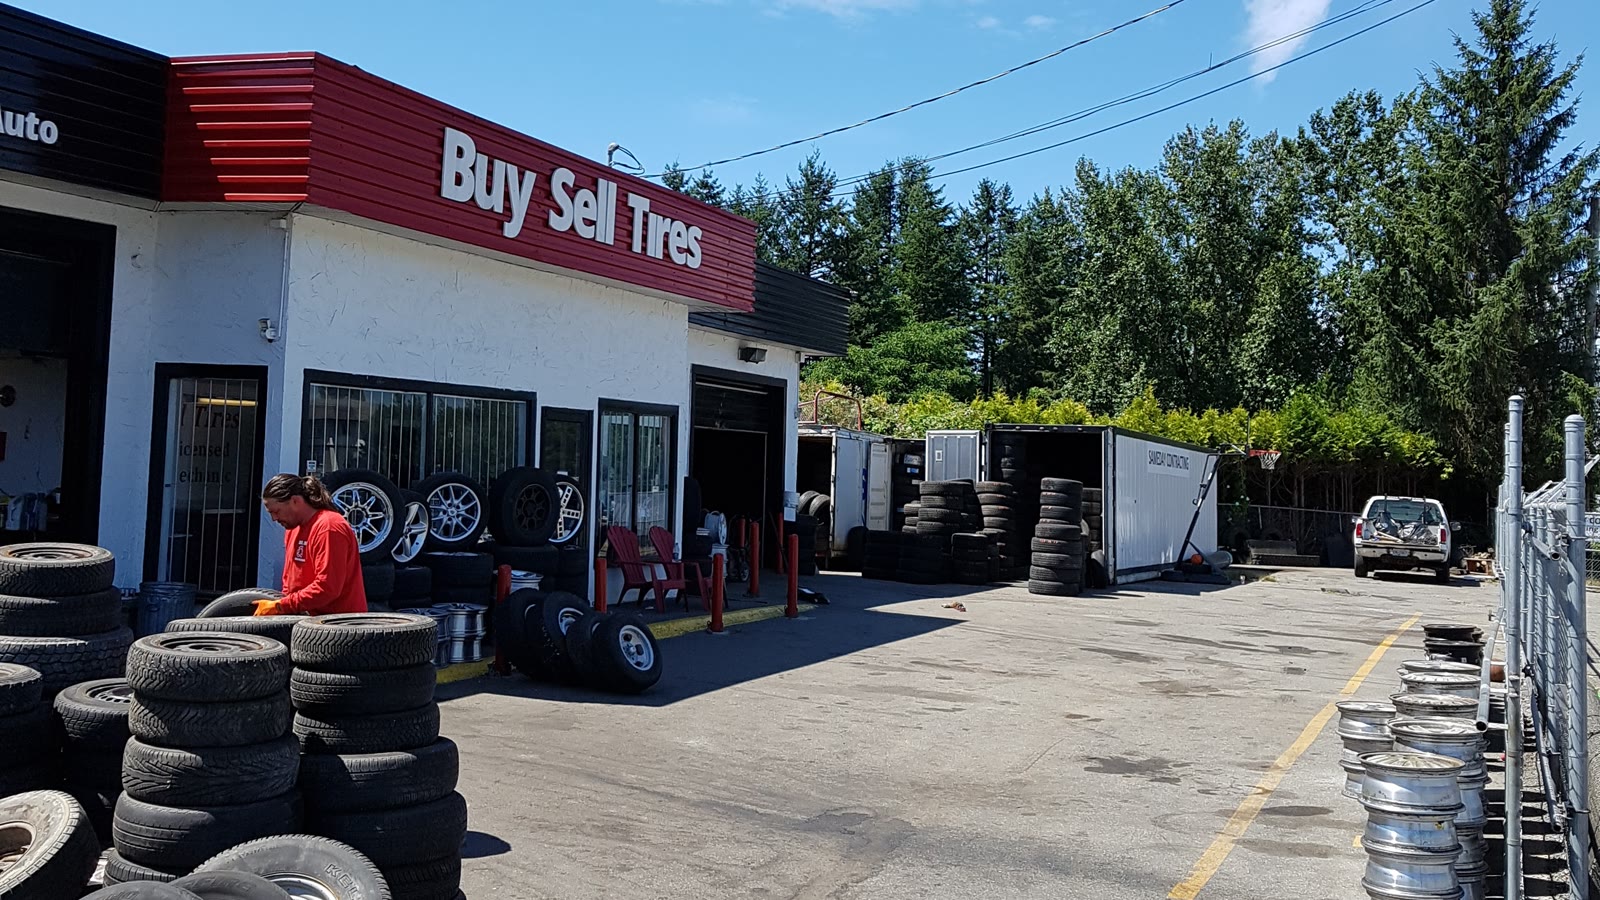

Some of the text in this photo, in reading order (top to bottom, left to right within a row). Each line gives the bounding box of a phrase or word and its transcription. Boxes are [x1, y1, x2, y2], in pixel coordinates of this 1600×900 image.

[0, 105, 58, 144] uto
[441, 126, 703, 269] Buy Sell Tires
[195, 406, 240, 428] Tires
